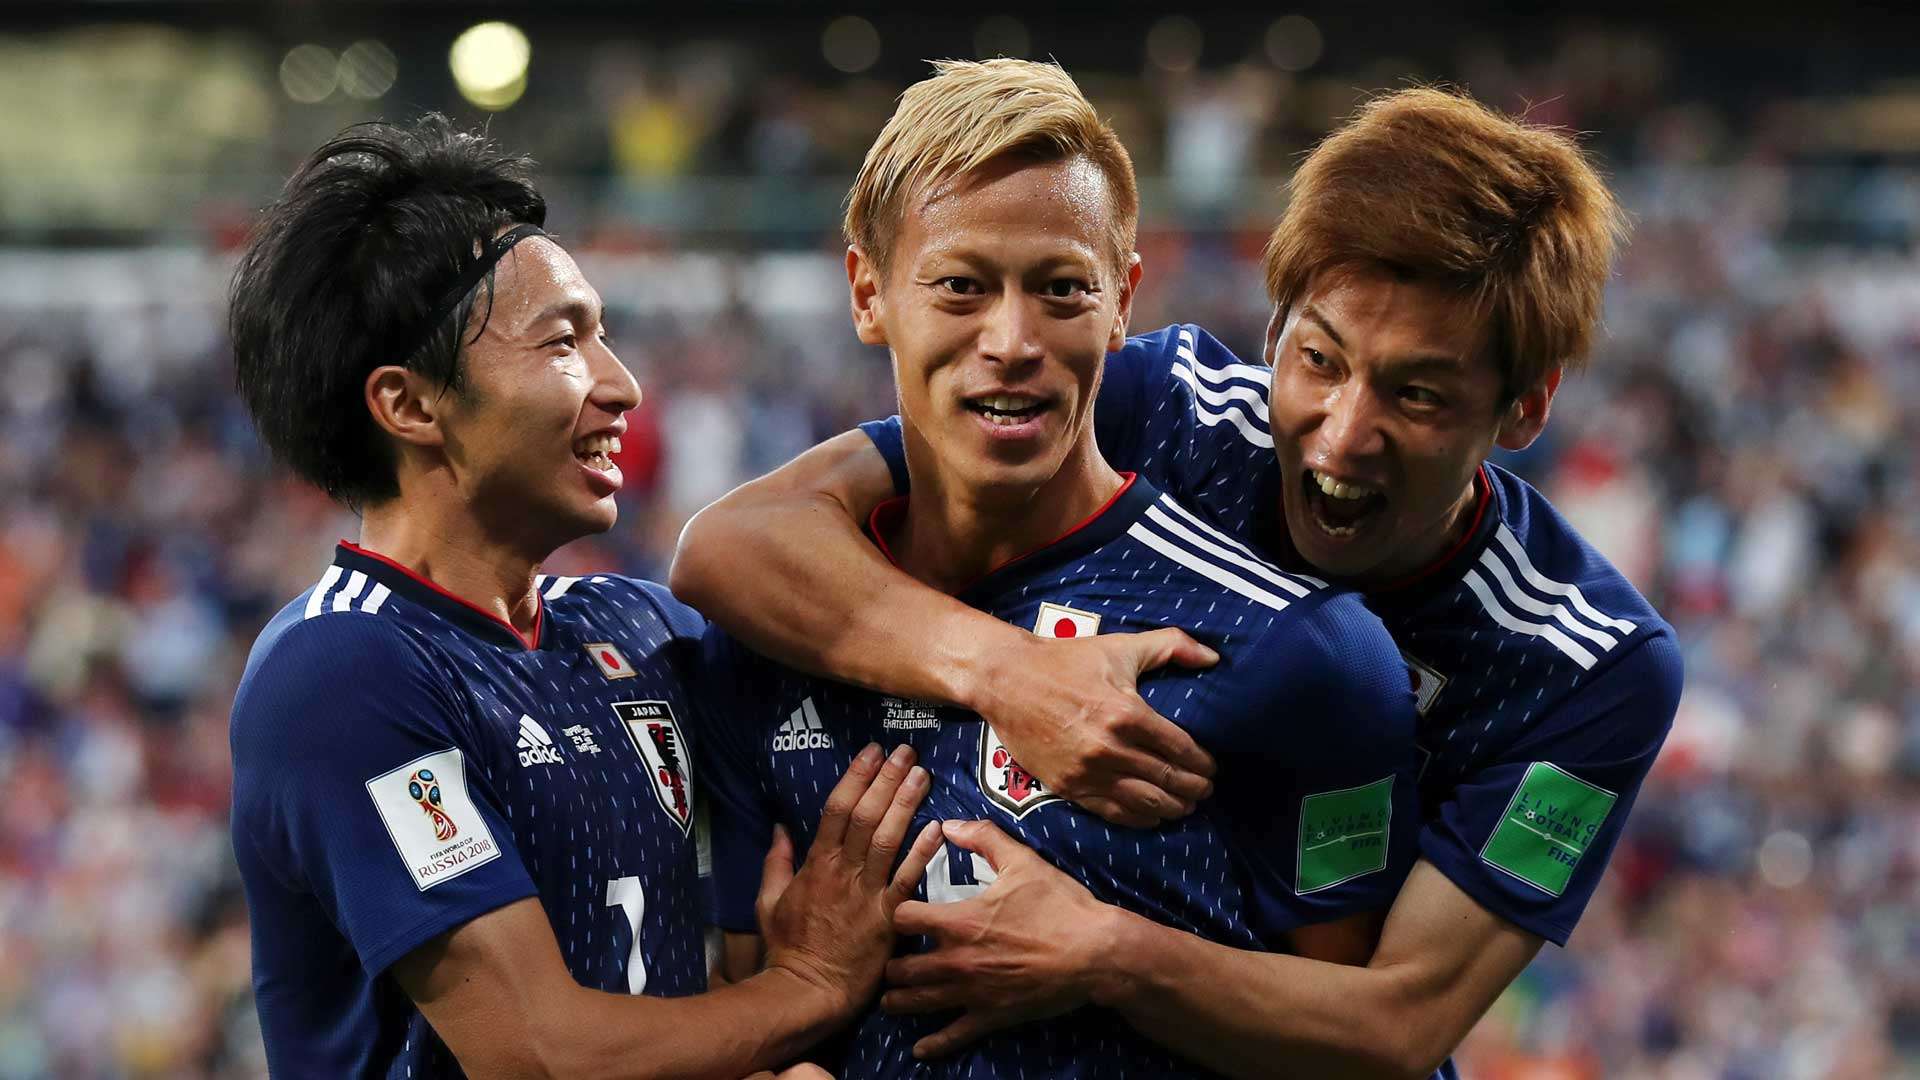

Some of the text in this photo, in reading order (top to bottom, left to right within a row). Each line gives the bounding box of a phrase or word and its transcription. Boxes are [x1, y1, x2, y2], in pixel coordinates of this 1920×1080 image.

[631, 705, 662, 717] JAPAN
[886, 708, 897, 718] 24
[897, 709, 916, 719] JUNE
[883, 718, 939, 730] EKATERINBURG
[772, 729, 832, 752] adidas
[998, 770, 1042, 791] JFA
[1521, 792, 1597, 835] LIVING
[418, 839, 491, 879] RUSSIA 2018
[430, 850, 444, 861] FIFA
[443, 841, 463, 854] WORLD
[1547, 846, 1578, 868] FIFA
[605, 876, 647, 996] 7
